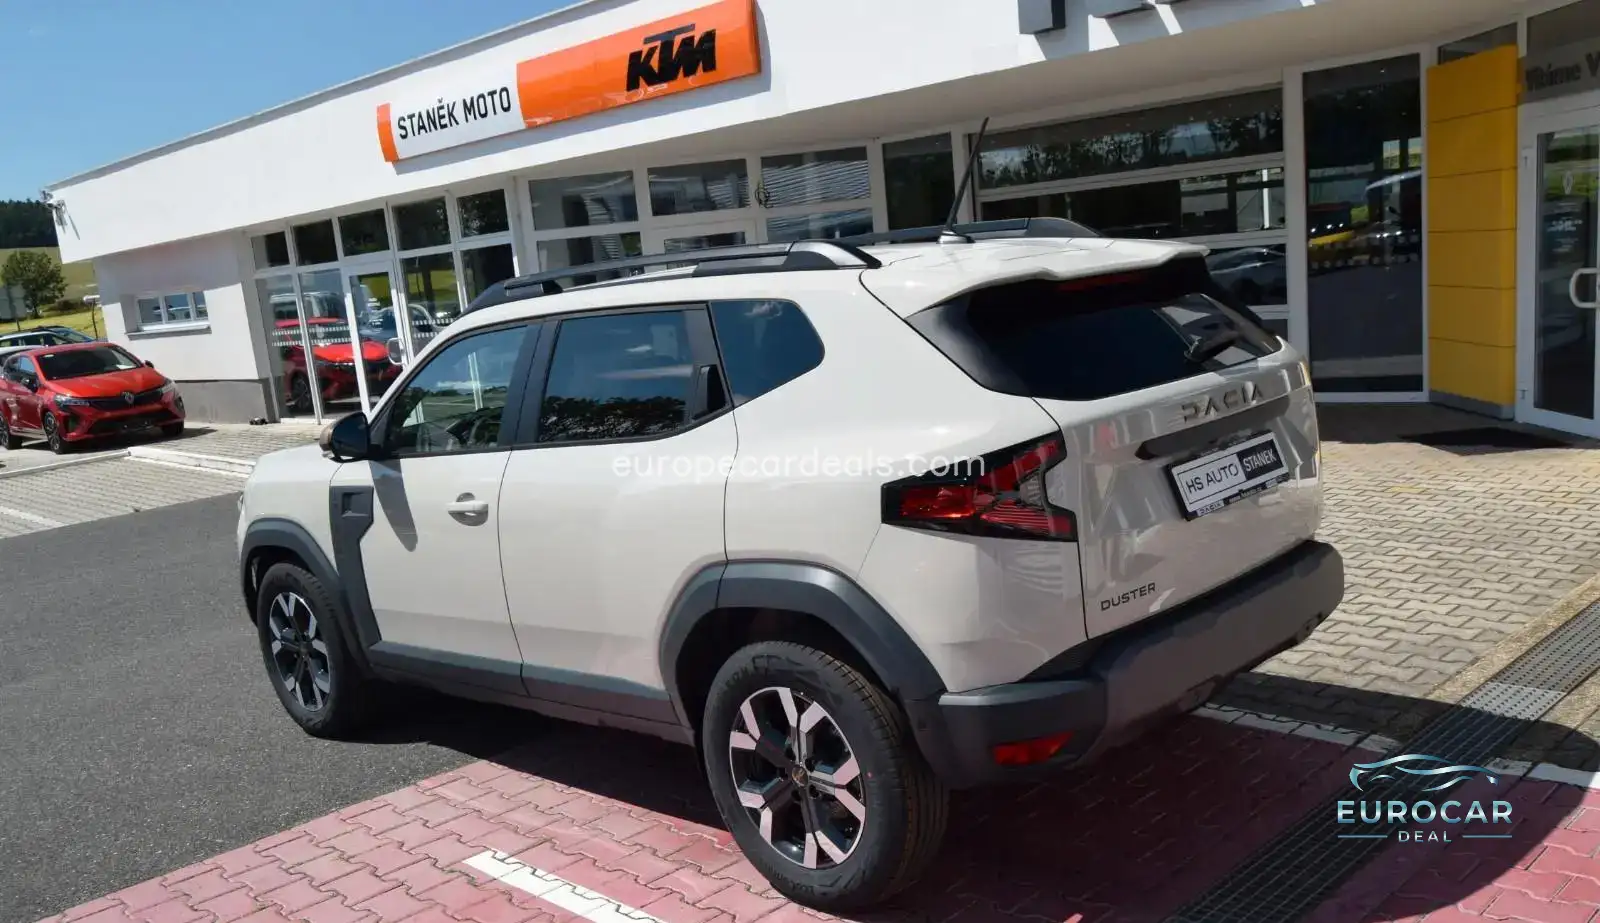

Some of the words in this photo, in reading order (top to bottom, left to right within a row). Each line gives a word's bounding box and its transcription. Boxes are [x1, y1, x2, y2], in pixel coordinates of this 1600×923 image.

[626, 23, 717, 92] KTM
[397, 97, 460, 139] STANĚK
[462, 86, 512, 123] MOTO
[1181, 383, 1264, 424] DACIA
[1185, 476, 1205, 494] HS
[1205, 463, 1239, 487] AUTO
[1100, 582, 1156, 612] DUSTER
